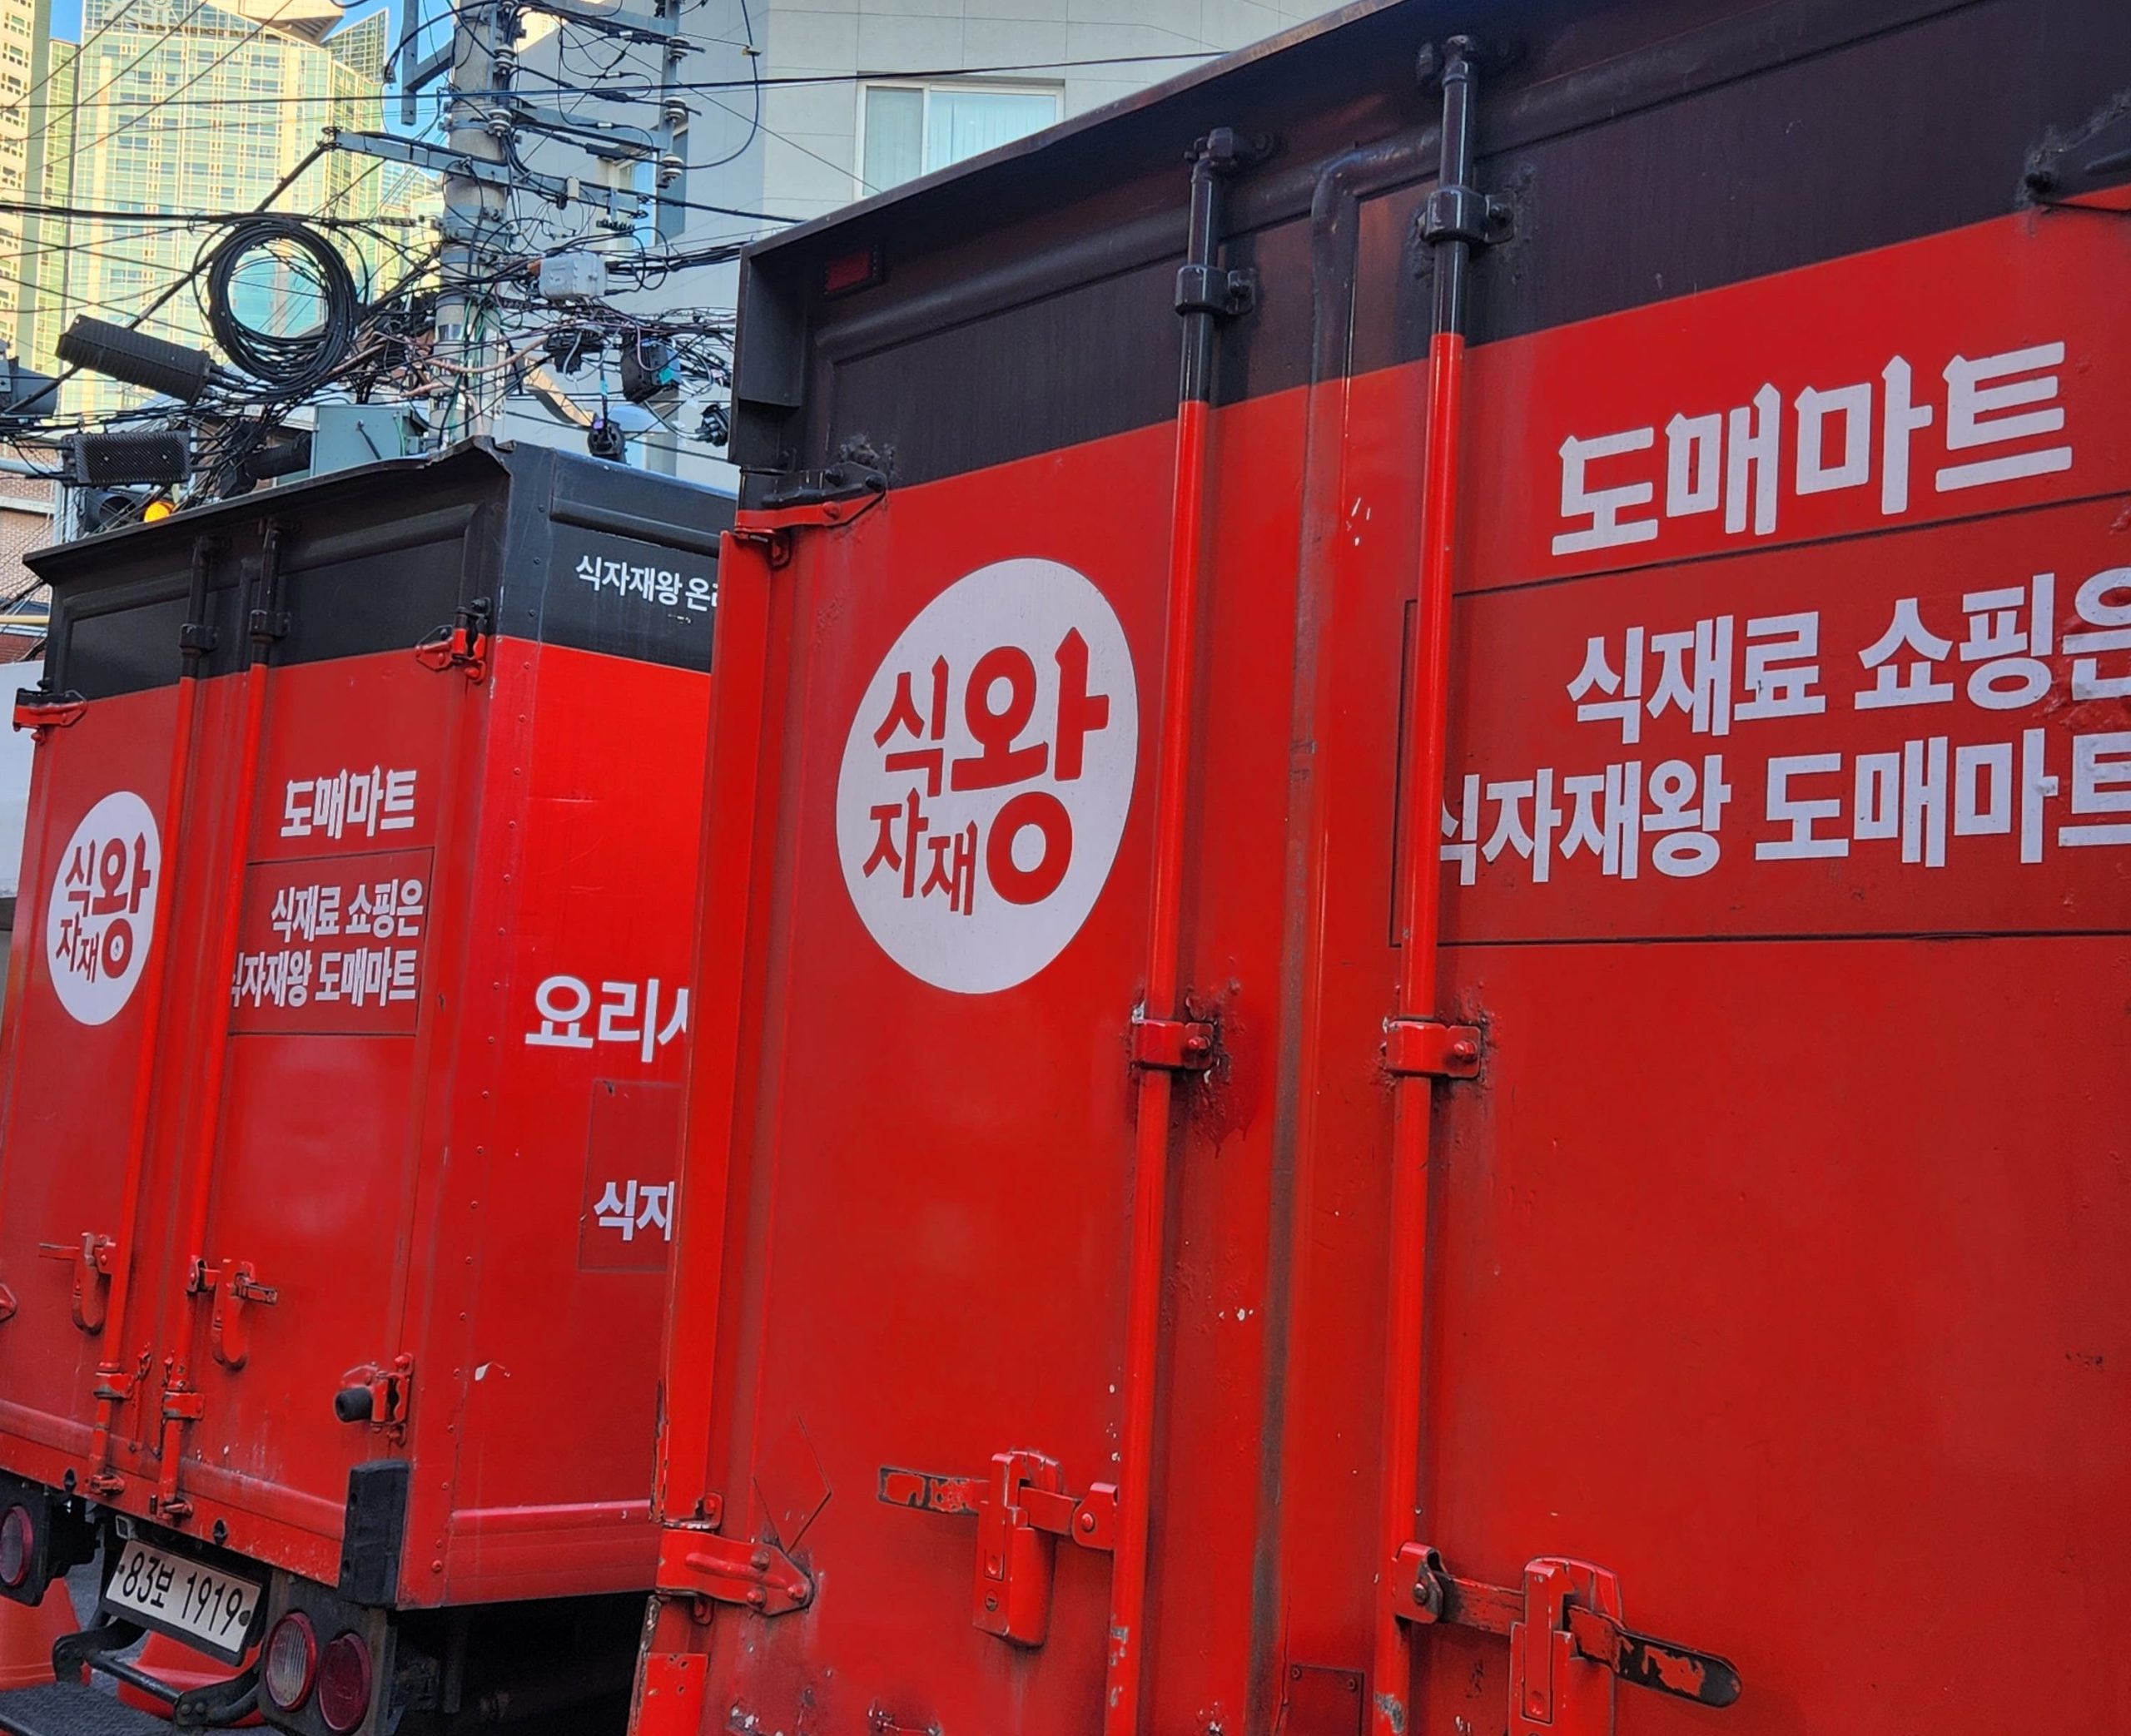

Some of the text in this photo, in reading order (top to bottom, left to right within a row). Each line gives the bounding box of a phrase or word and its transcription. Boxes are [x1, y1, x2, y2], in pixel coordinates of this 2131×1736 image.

[1552, 340, 2073, 556] 도매마트
[575, 555, 683, 606] 식자재왕
[1567, 567, 2131, 744] 식재료 쇼핑은
[280, 765, 416, 839] 도매마트
[1440, 728, 2131, 886] 식자재왕 도매마트
[271, 879, 423, 942] 식재료 쇼핑은
[315, 946, 416, 1007] 도매마트
[122, 1550, 243, 1636] 83보 1919
